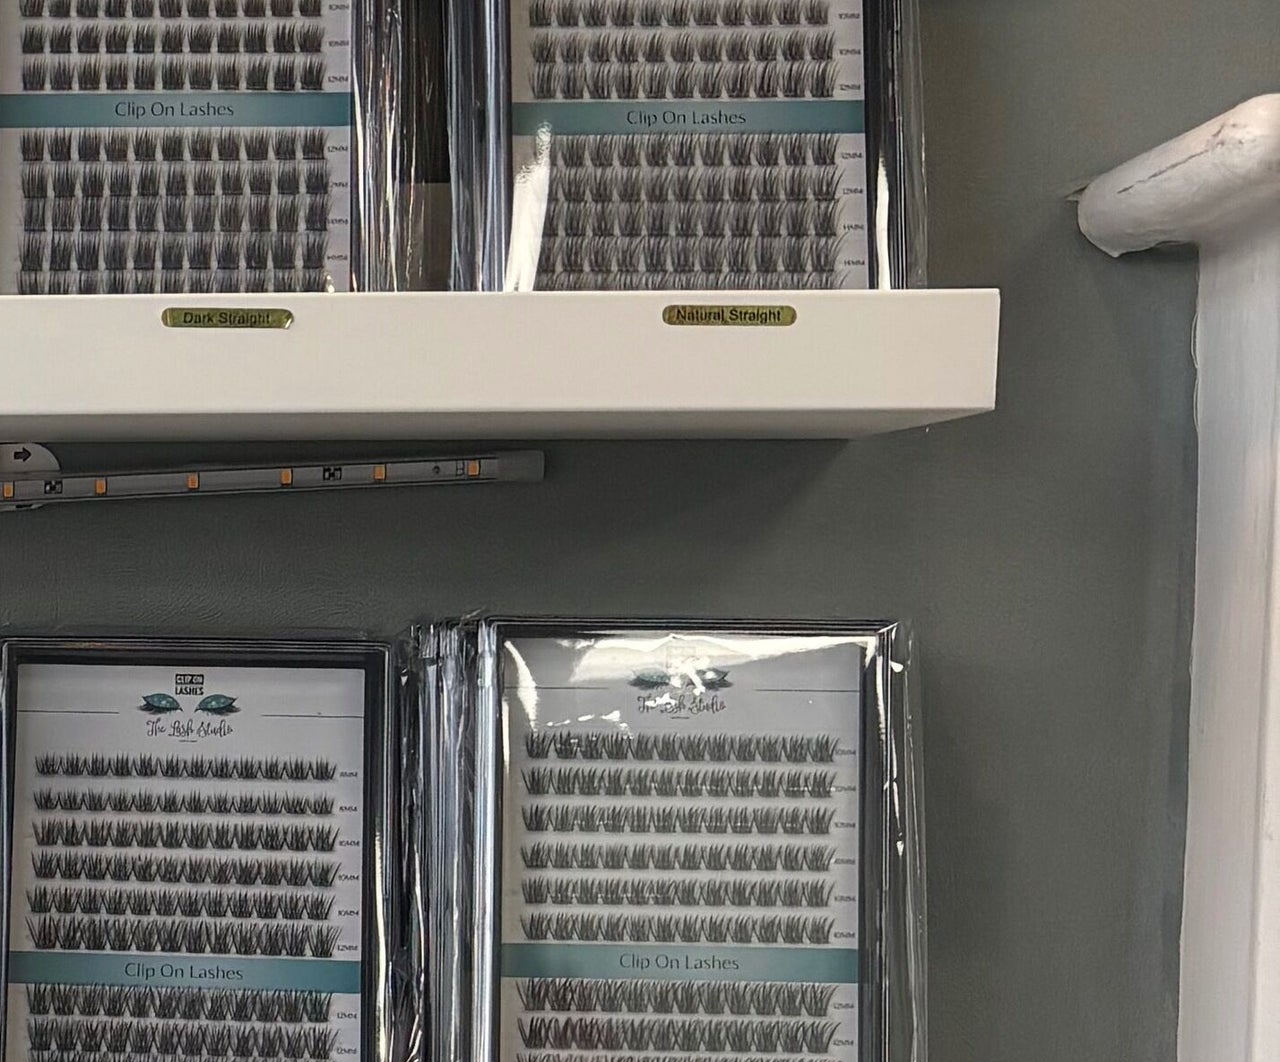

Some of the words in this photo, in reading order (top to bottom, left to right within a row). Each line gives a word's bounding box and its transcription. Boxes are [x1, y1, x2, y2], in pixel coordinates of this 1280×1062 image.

[115, 101, 146, 119] Clip
[151, 102, 174, 117] On
[180, 102, 234, 117] Lashes
[627, 110, 657, 127] Clip
[662, 110, 686, 125] On
[692, 110, 746, 125] Lashes
[183, 311, 215, 325] Dark
[219, 311, 271, 327] Straight
[676, 308, 724, 322] Natural
[729, 308, 781, 324] Straight
[175, 686, 204, 696] LASHES
[619, 953, 650, 971] Clip
[655, 954, 680, 969] On
[685, 954, 739, 970] Lashes
[125, 962, 155, 980] Clip
[160, 963, 184, 978] On
[190, 964, 243, 980] Lashes
